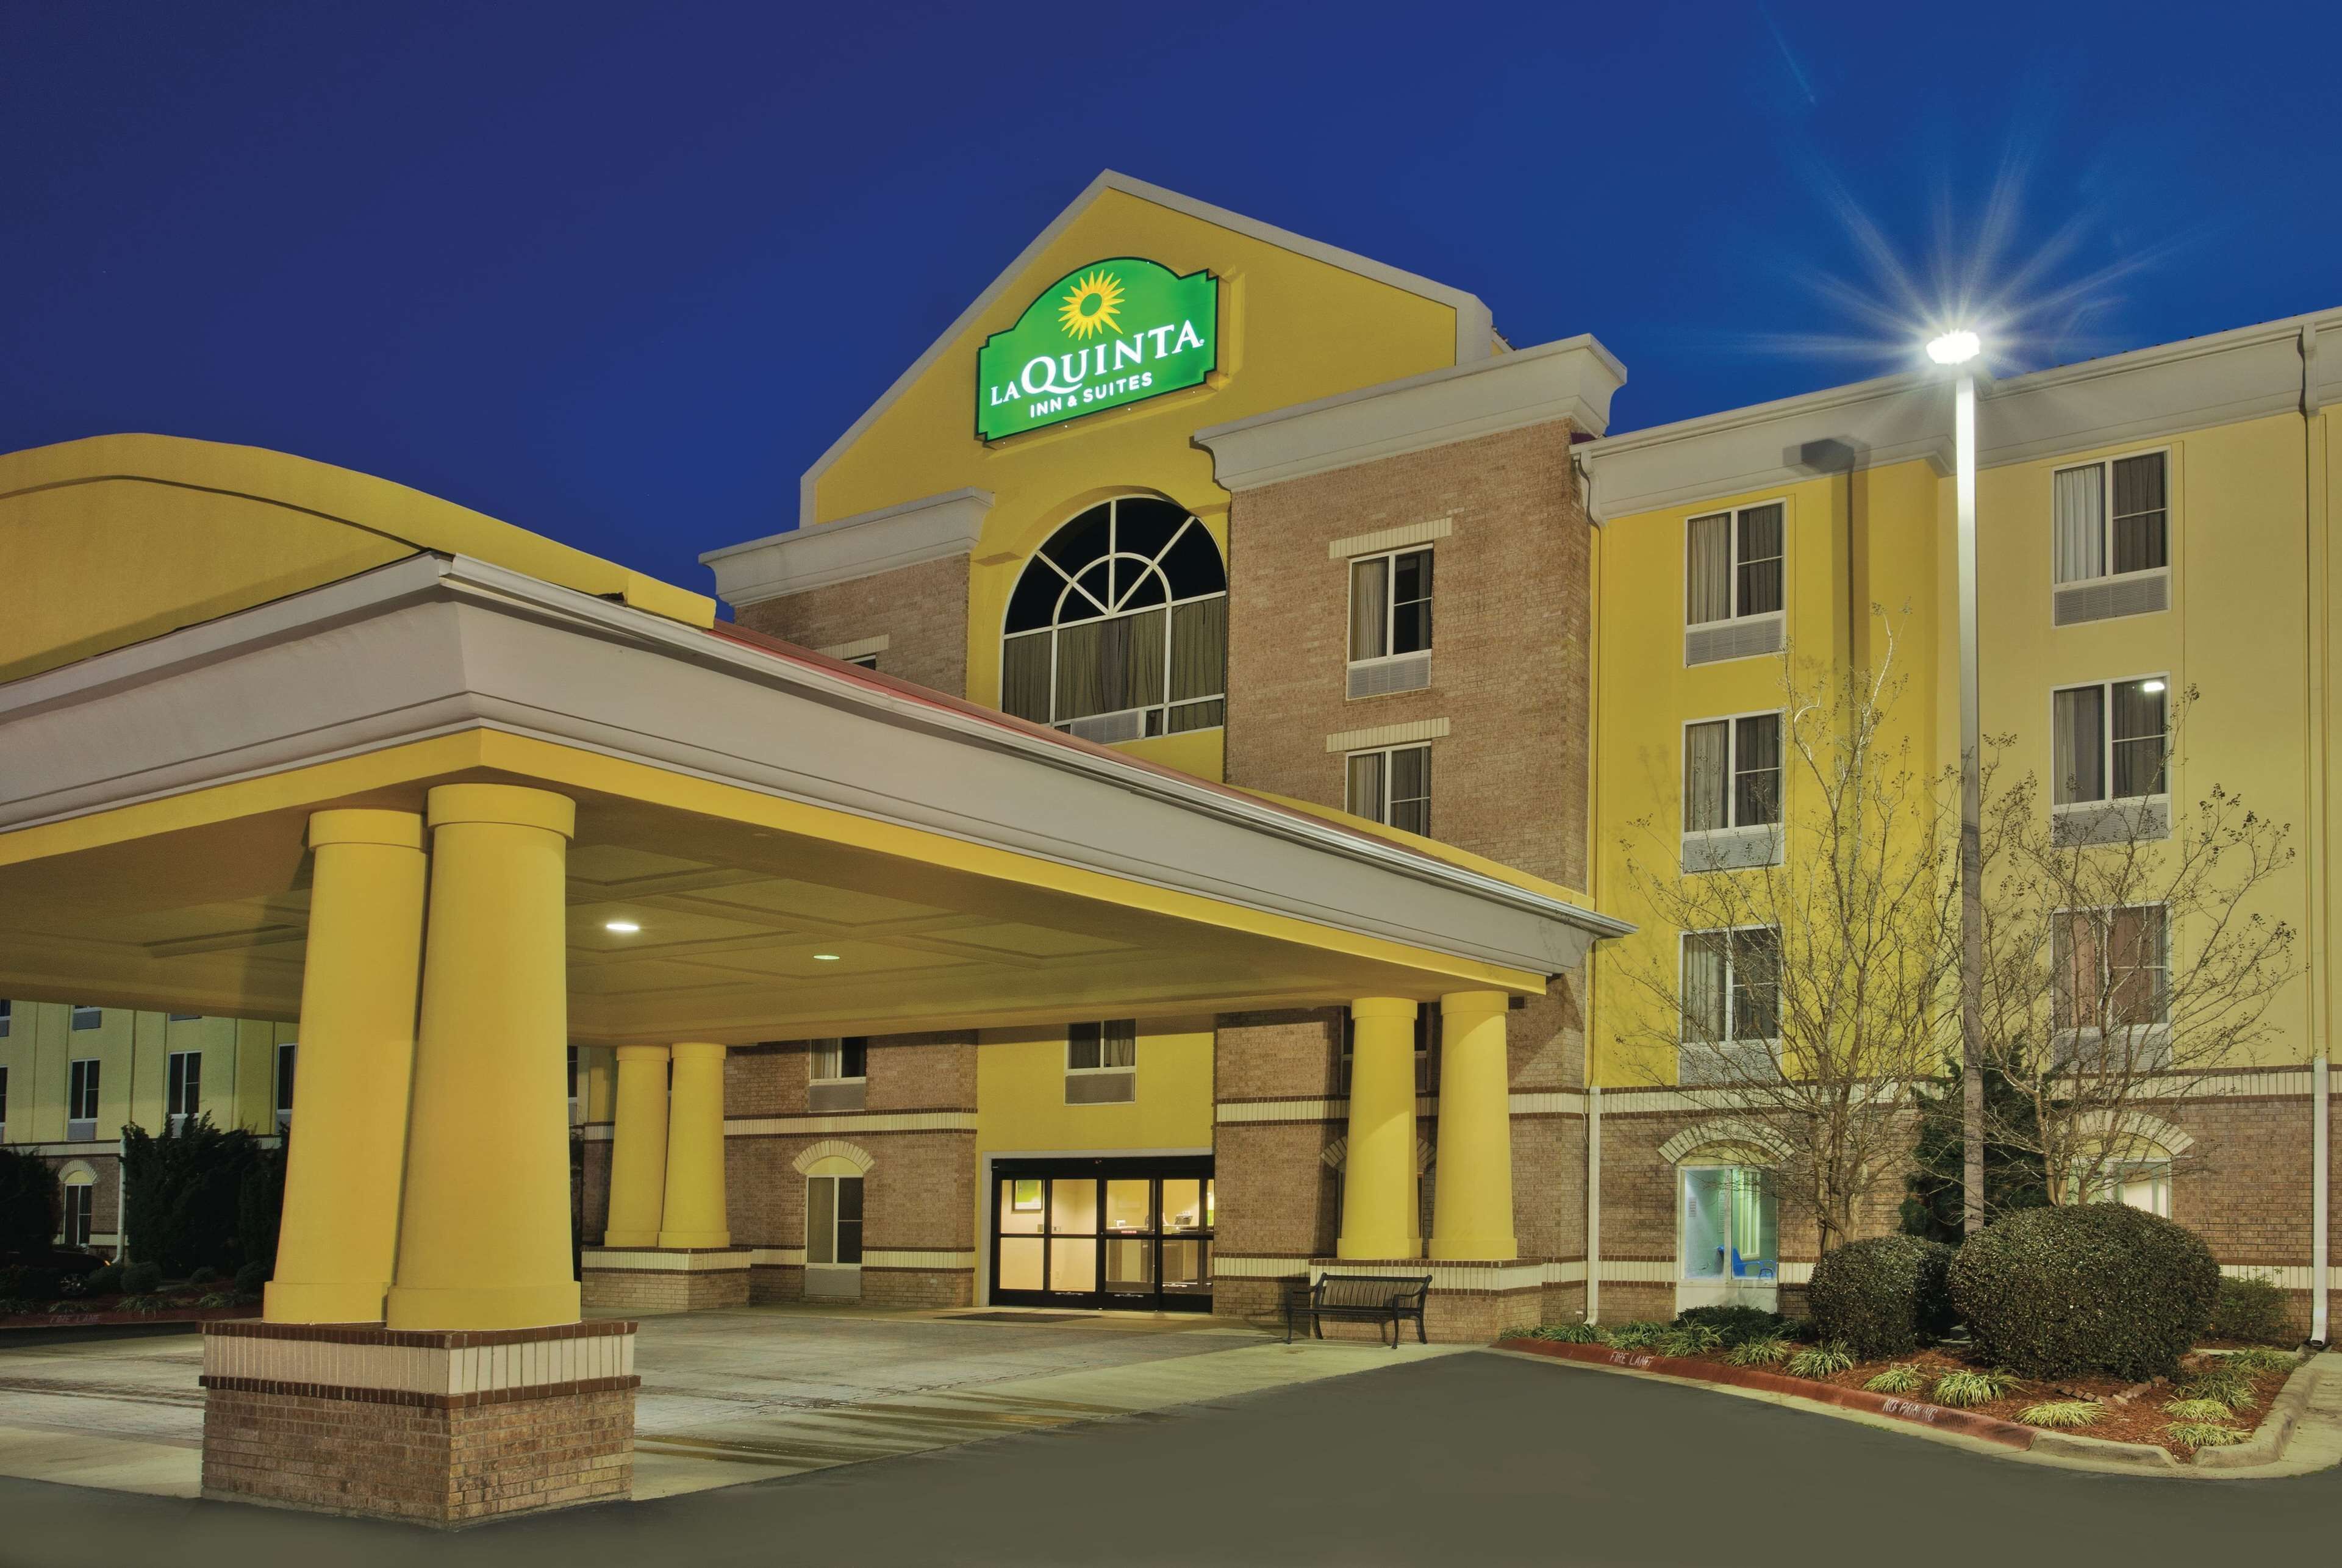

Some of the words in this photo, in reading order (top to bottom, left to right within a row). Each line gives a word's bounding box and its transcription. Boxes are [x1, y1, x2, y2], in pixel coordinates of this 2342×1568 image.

[990, 381, 1022, 406] LA
[1021, 320, 1204, 394] QUINTA
[1030, 396, 1062, 418] INN
[1067, 395, 1078, 407] &
[1083, 371, 1152, 403] SUITES
[1610, 1351, 1630, 1364] FIRE
[1883, 1398, 1899, 1412] NO
